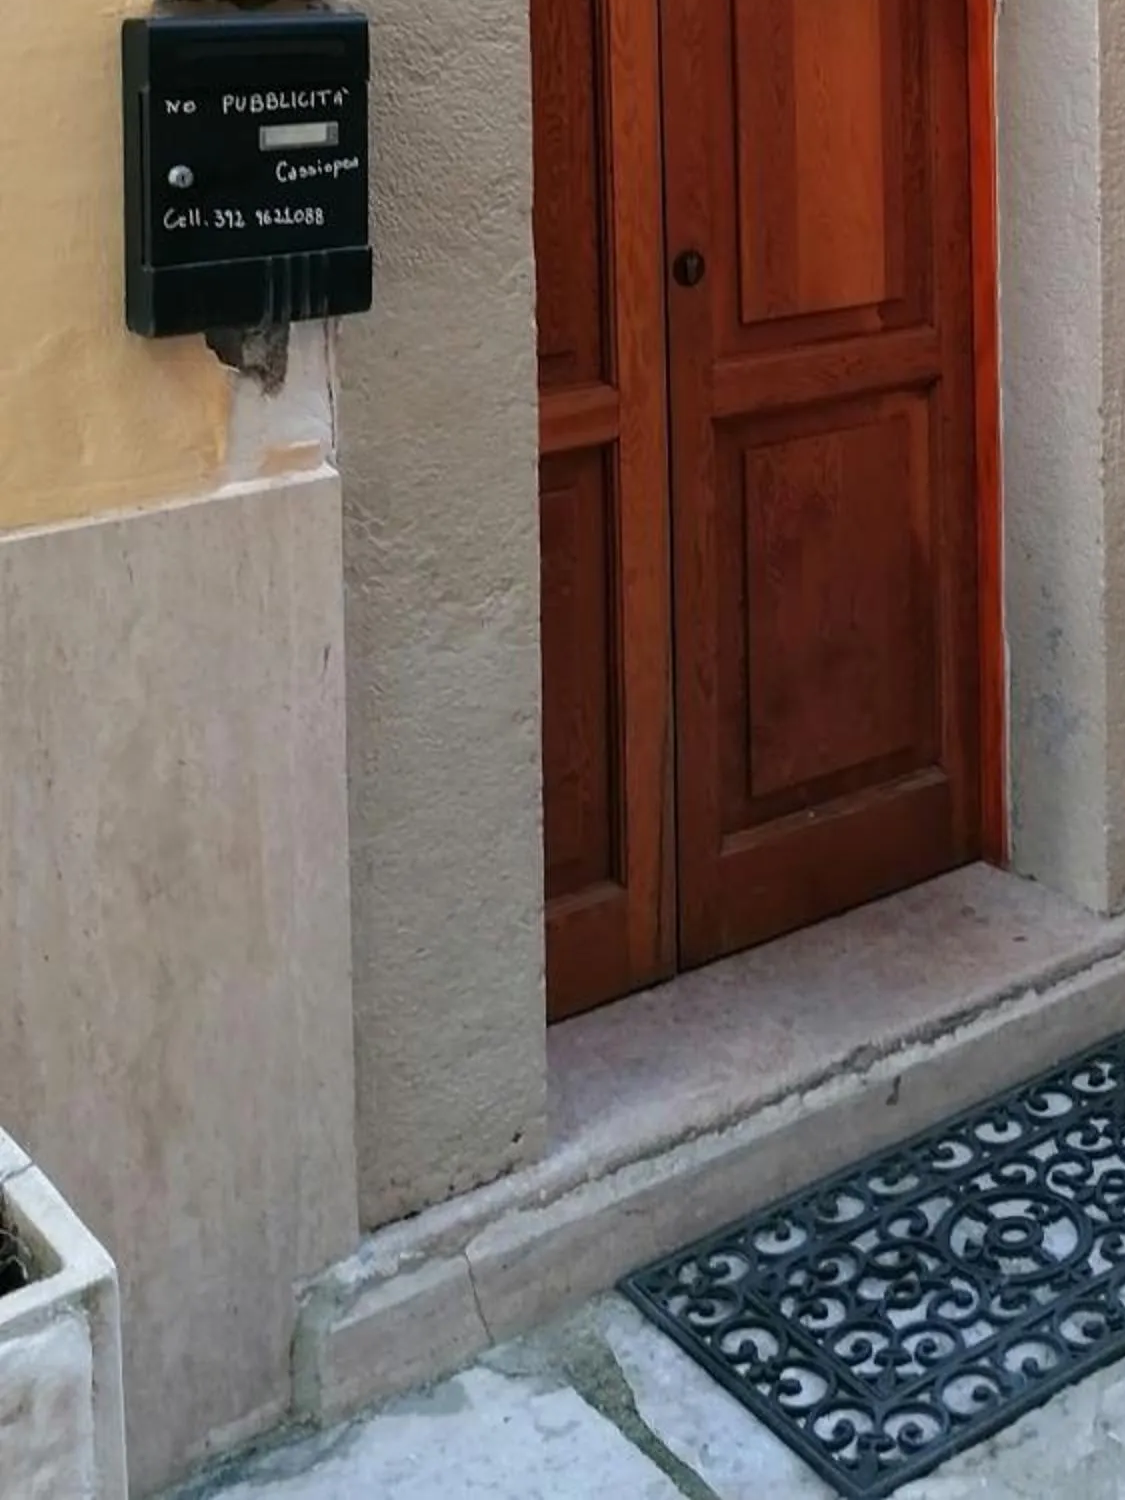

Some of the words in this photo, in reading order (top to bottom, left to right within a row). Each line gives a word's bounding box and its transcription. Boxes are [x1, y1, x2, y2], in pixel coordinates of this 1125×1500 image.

[165, 99, 197, 114] NO
[222, 86, 350, 115] PUBBLICITÀ
[213, 208, 246, 229] 392
[255, 206, 325, 228] 9621088
